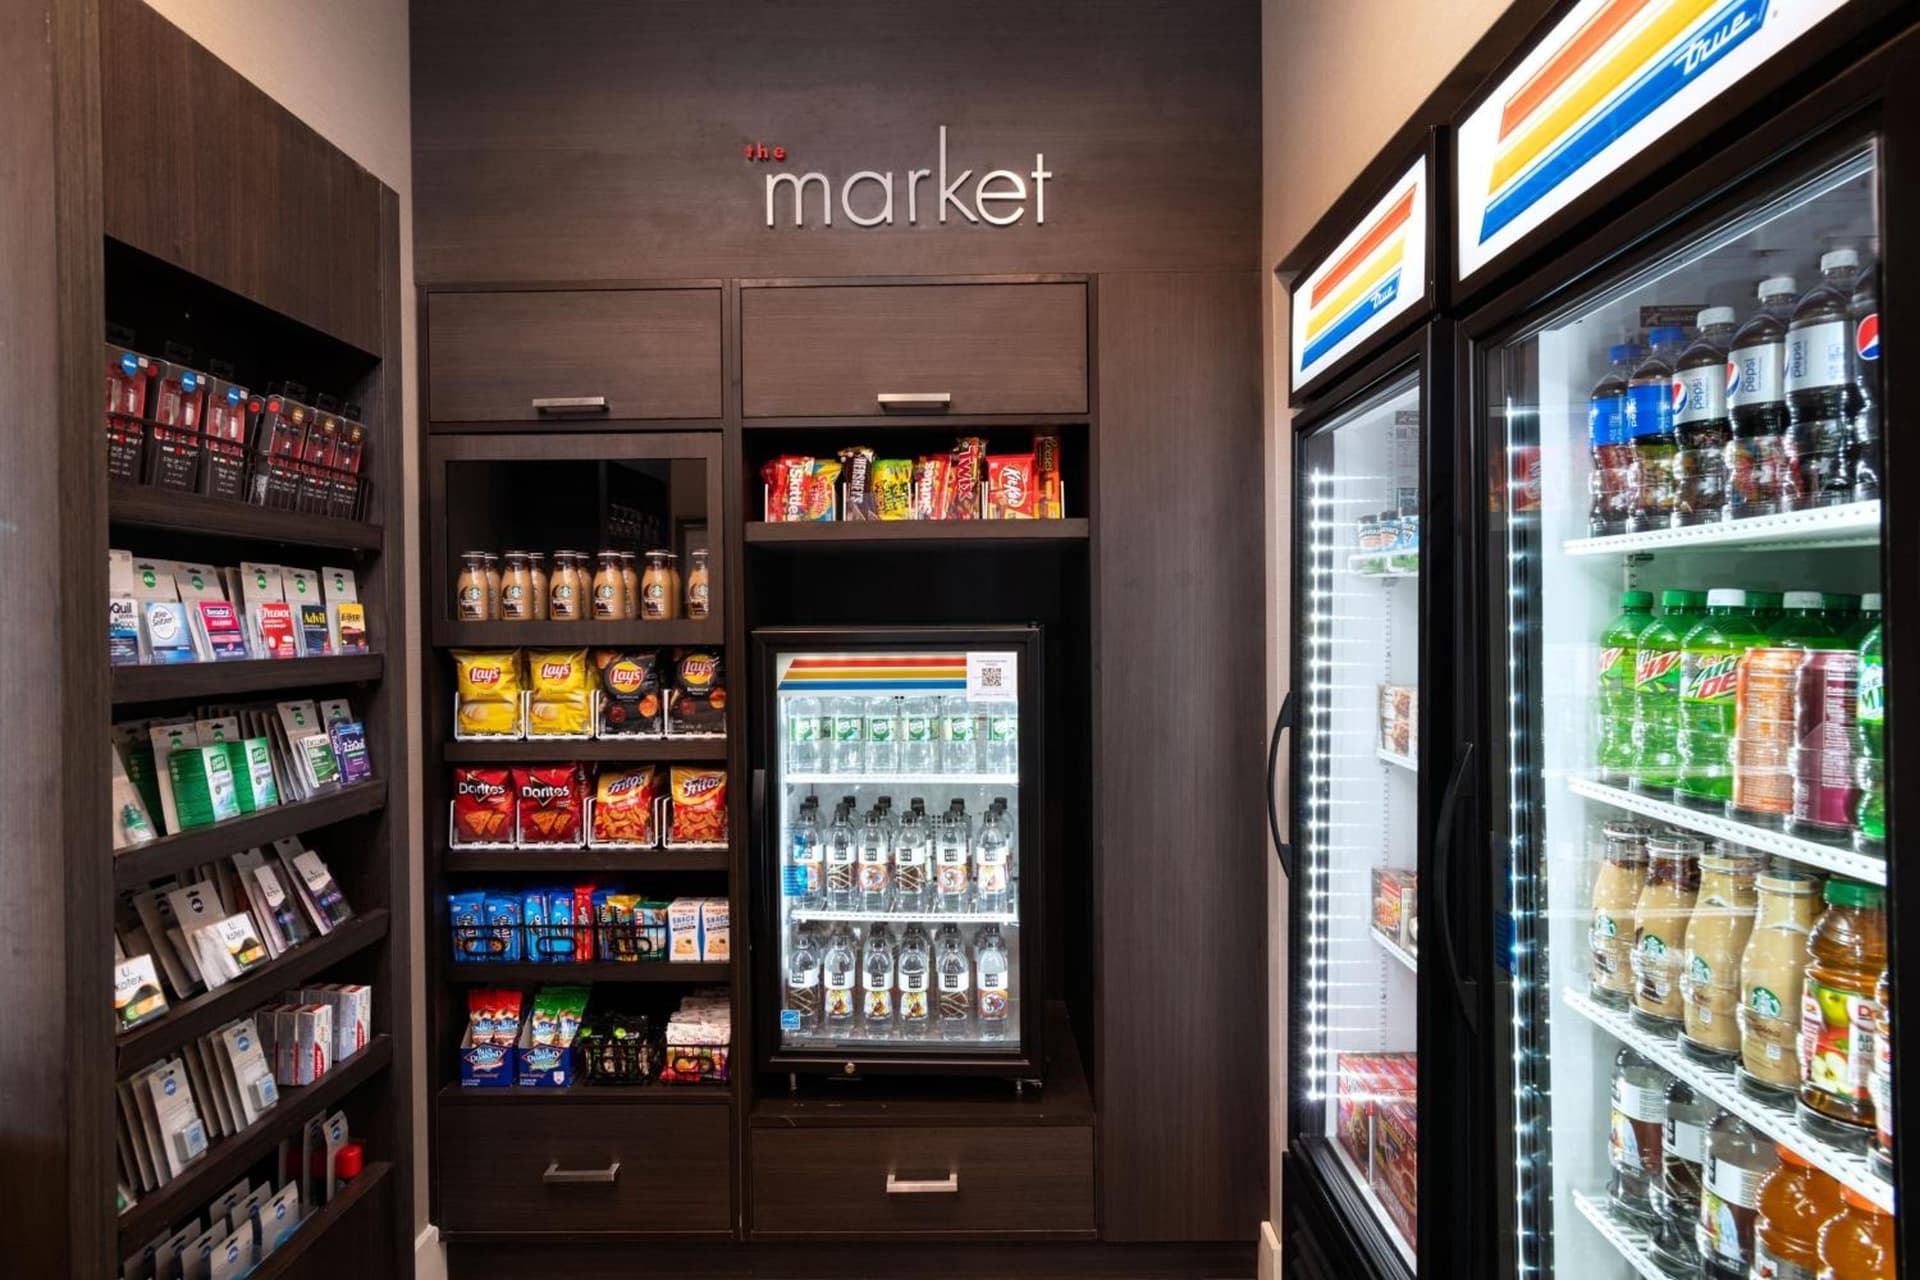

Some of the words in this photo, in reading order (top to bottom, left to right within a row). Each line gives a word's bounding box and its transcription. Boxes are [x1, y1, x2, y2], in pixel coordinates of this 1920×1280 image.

[746, 145, 786, 160] the
[766, 125, 1052, 226] market
[1744, 358, 1757, 393] pepsi
[1692, 378, 1705, 410] pepsi
[788, 467, 803, 521] Skittles
[304, 612, 326, 624] Advil
[459, 782, 506, 795] Doritos
[522, 785, 570, 798] Doritos
[683, 777, 721, 797] Fritos
